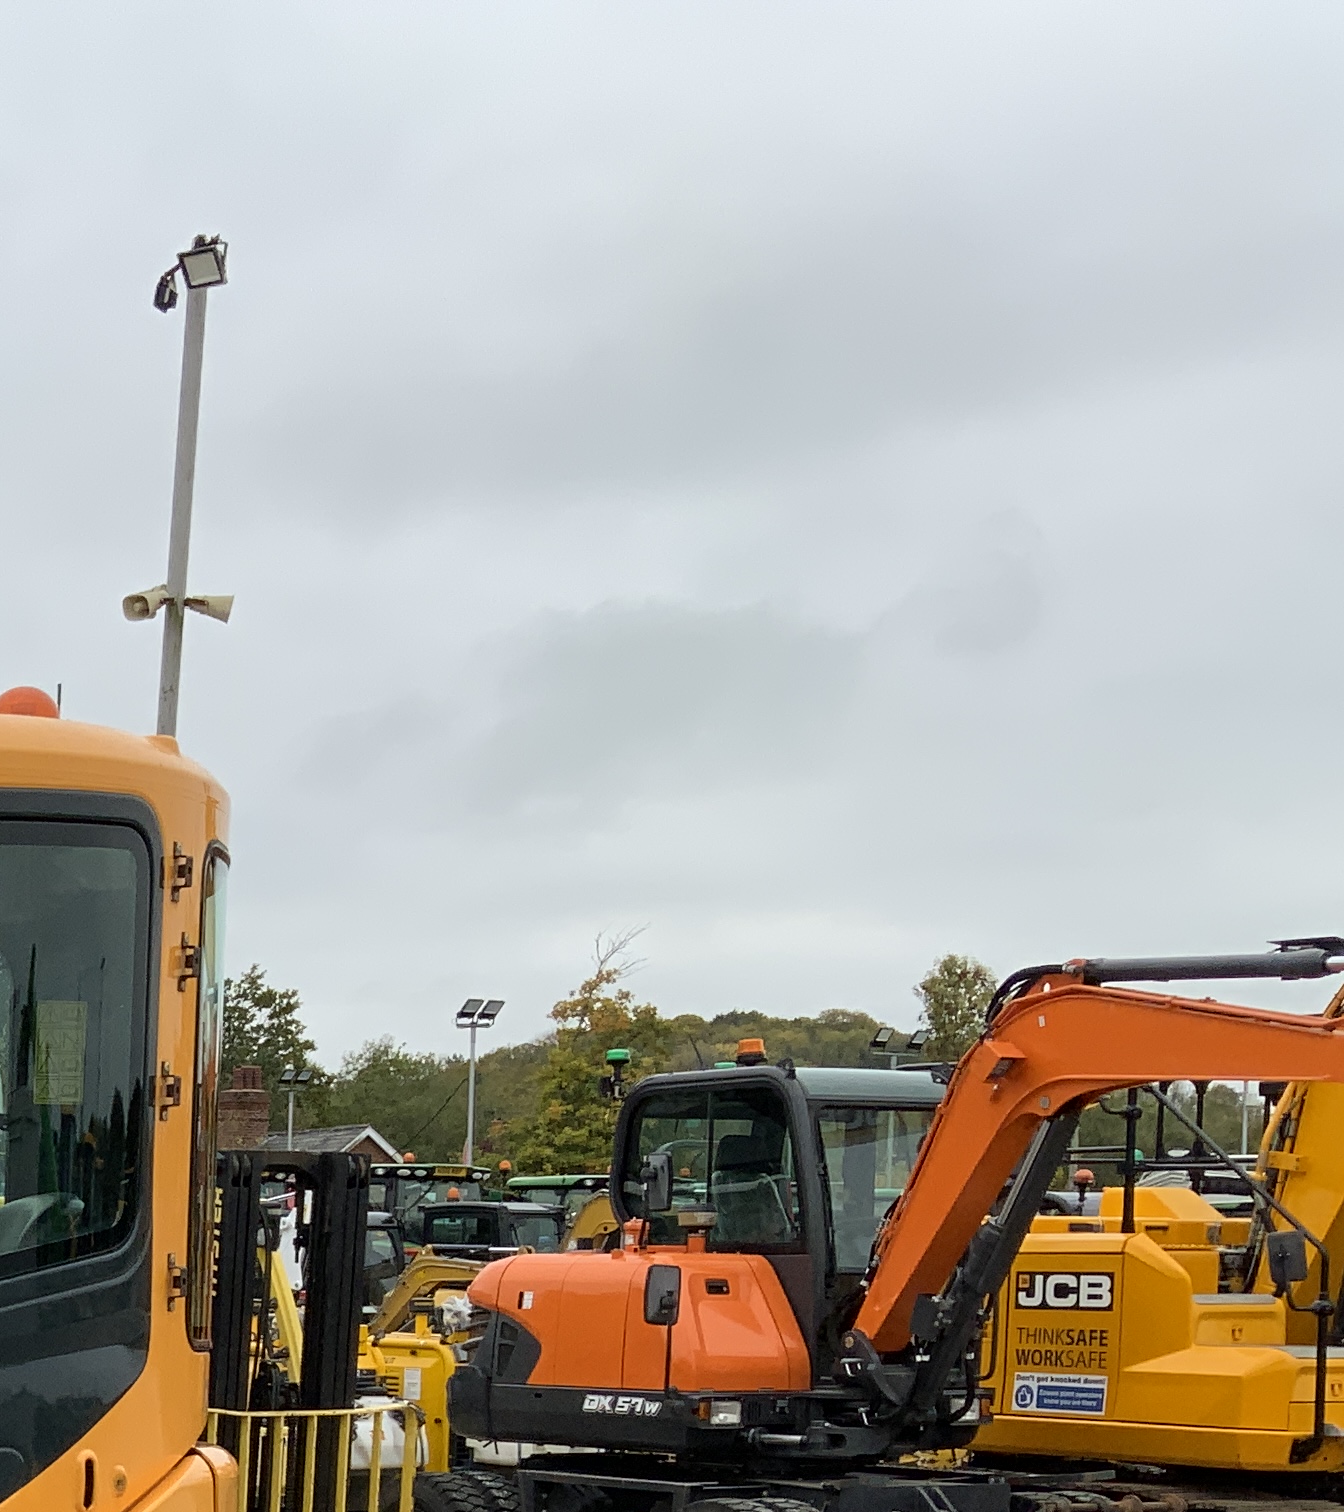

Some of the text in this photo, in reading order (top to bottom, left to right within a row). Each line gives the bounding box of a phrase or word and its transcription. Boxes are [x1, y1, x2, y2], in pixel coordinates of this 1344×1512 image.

[1017, 1274, 1112, 1308] JCB
[1016, 1327, 1109, 1348] THINKSAFE
[1015, 1348, 1108, 1370] WORKSAFE
